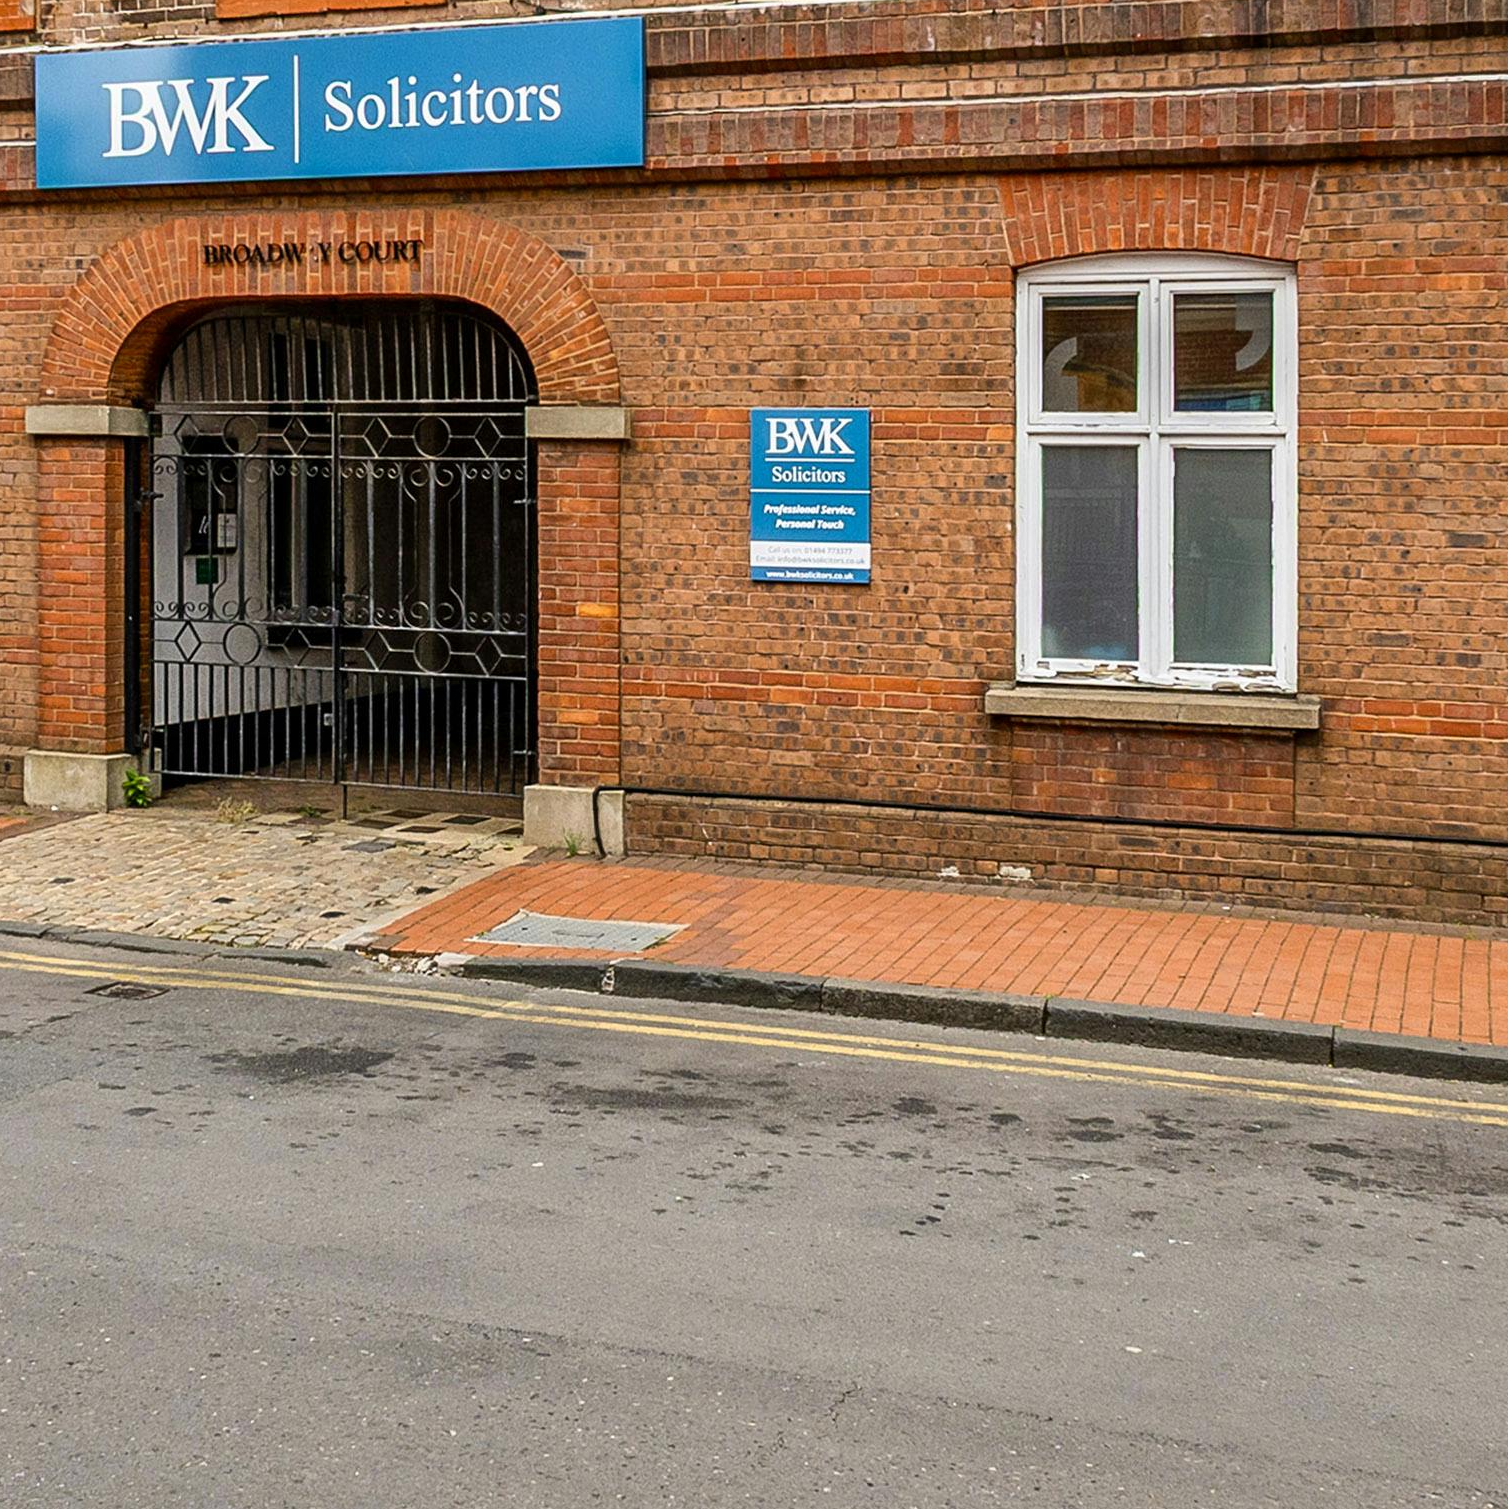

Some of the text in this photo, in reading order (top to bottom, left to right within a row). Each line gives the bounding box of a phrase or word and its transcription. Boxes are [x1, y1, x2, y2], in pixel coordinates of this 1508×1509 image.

[102, 72, 562, 158] BWK Solicitors
[202, 239, 426, 267] BROADWY COURT
[765, 418, 855, 454] BWK
[772, 465, 846, 483] Solicitors
[763, 503, 856, 517] Professional Service,
[775, 518, 844, 530] Personal Touch
